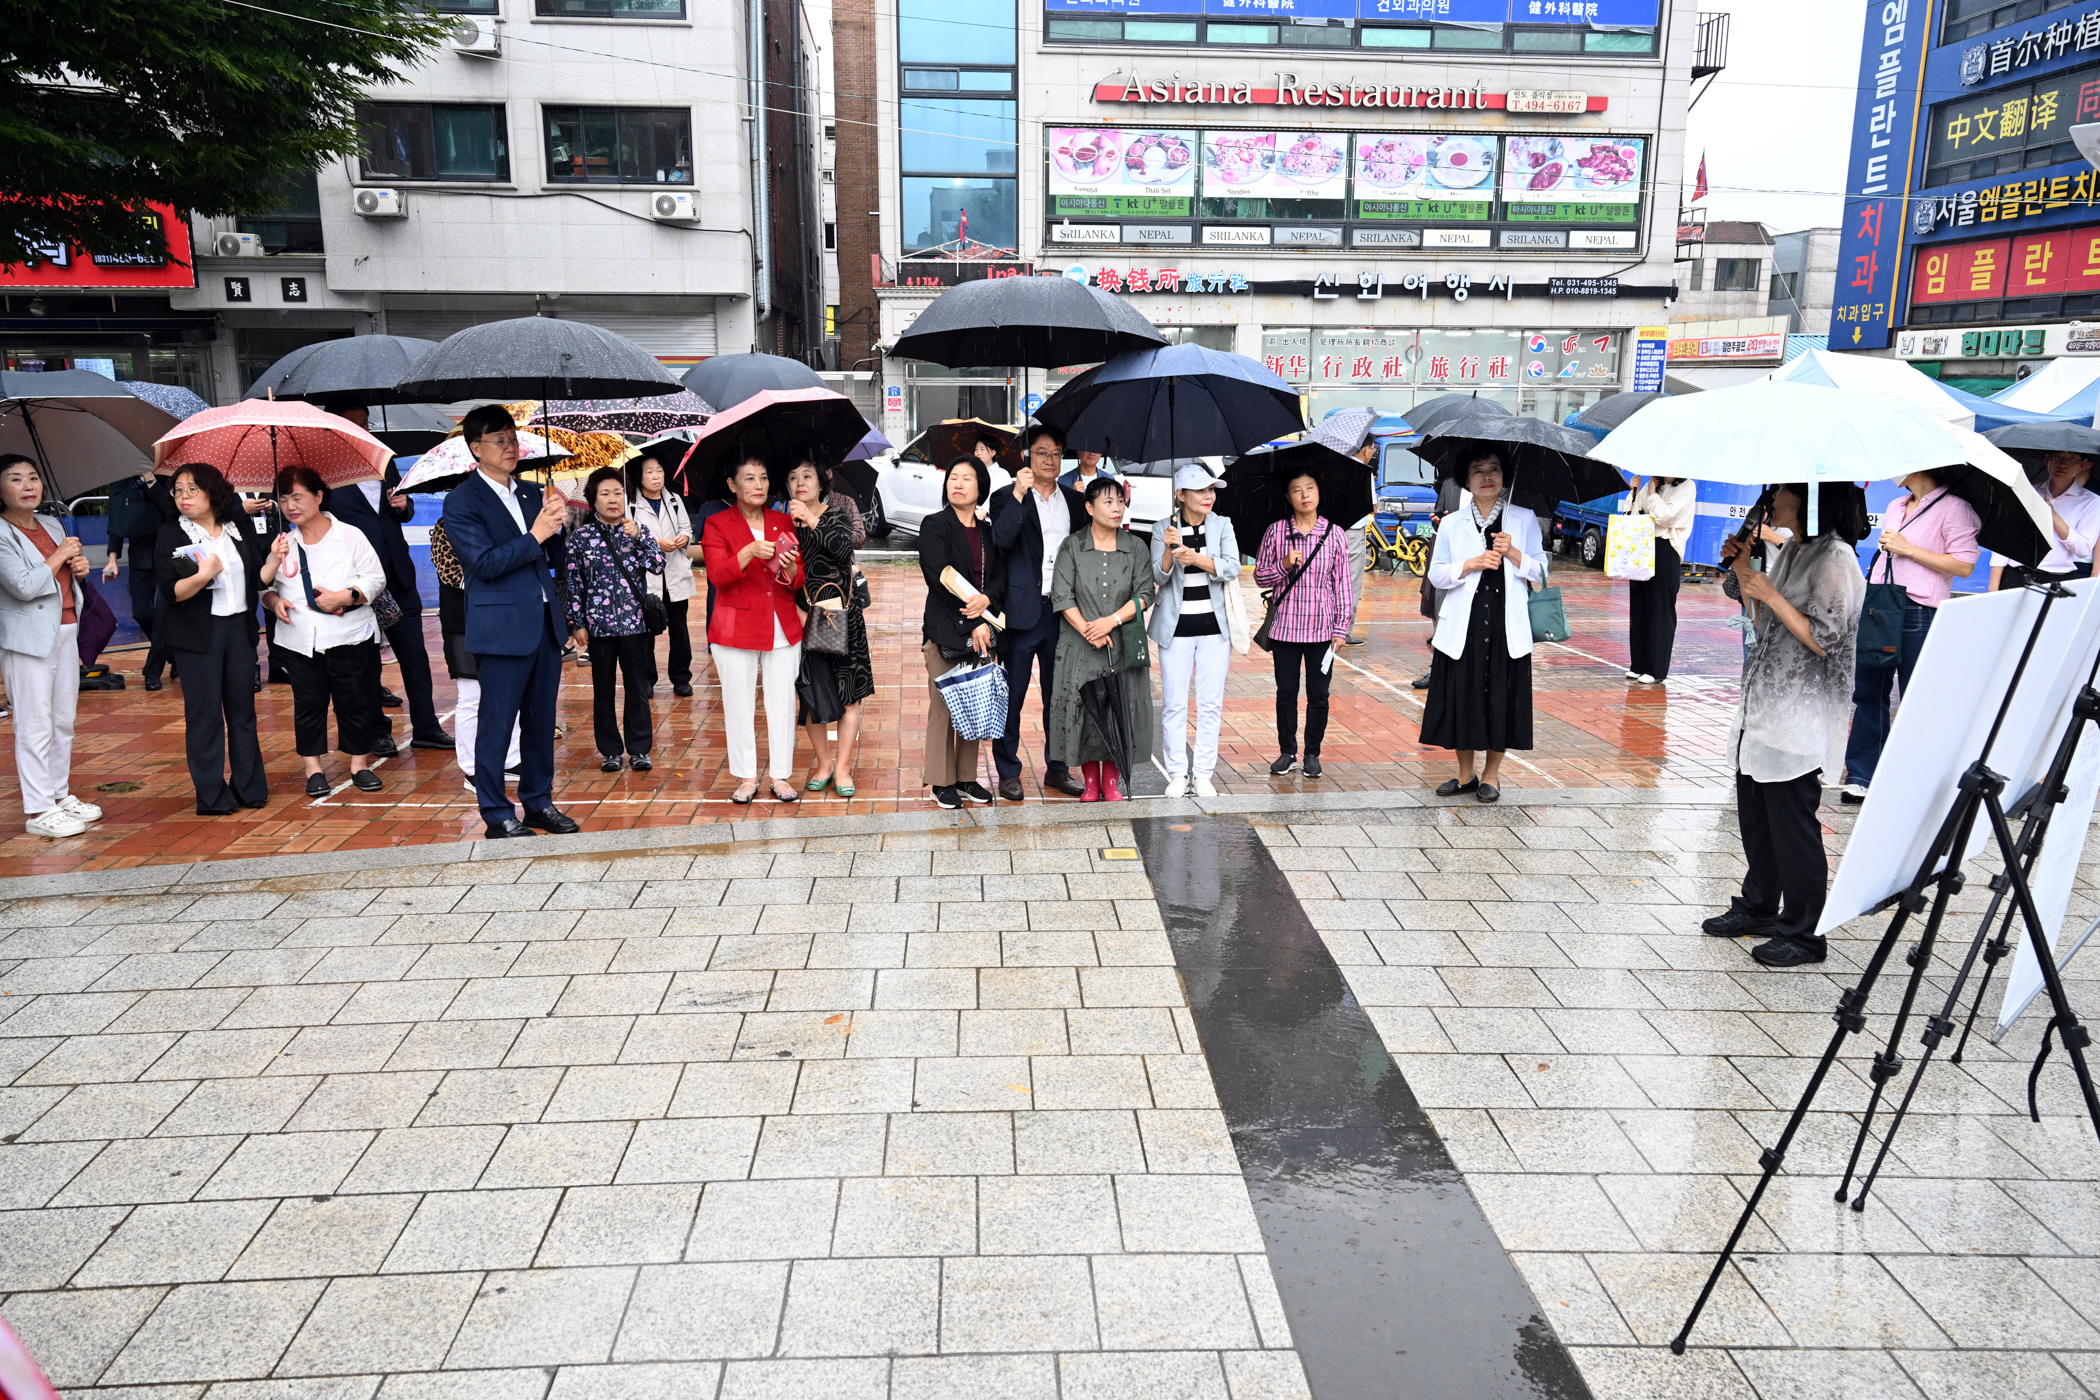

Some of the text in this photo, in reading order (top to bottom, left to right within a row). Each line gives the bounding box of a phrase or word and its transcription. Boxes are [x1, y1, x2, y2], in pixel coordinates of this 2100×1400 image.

[1990, 9, 2100, 76] 首尔种植
[1119, 68, 1488, 110] Asiana Restaurant
[1513, 91, 1528, 99] 인도
[1531, 91, 1553, 100] 음식점
[1512, 100, 1581, 111] T.494-6167
[1947, 90, 2059, 149] 中文翻译
[1851, 0, 1909, 295] 엠플란트 치과
[1936, 168, 2100, 227] 서울엠플란트치
[1060, 198, 1106, 208] 아시아나통신
[1127, 198, 1138, 209] kt
[1364, 203, 1408, 212] 아시아나통신
[1428, 203, 1439, 213] kt
[1512, 205, 1555, 215] 아시아나통신
[1575, 205, 1586, 215] kt
[1060, 229, 1115, 240] SRILANKA
[1139, 230, 1174, 240] NEPAL
[1210, 231, 1264, 241] SRILANKA
[1291, 232, 1325, 241] NEPAL
[1360, 233, 1413, 243] SRILANKA
[1439, 234, 1473, 244] NEPAL
[1507, 235, 1560, 244] SRILANKA
[1585, 235, 1618, 245] NEPAL
[1097, 266, 1249, 293] 换钱所 旅行社
[1566, 279, 1617, 287] 031-495-1345
[1313, 271, 1516, 301] 신화여행사
[1566, 287, 1617, 295] 010-8819-1345
[1837, 302, 1884, 323] 치과입구
[1961, 329, 2046, 356] 현대마트
[1263, 354, 1510, 379] 新华 行政社 旅行社
